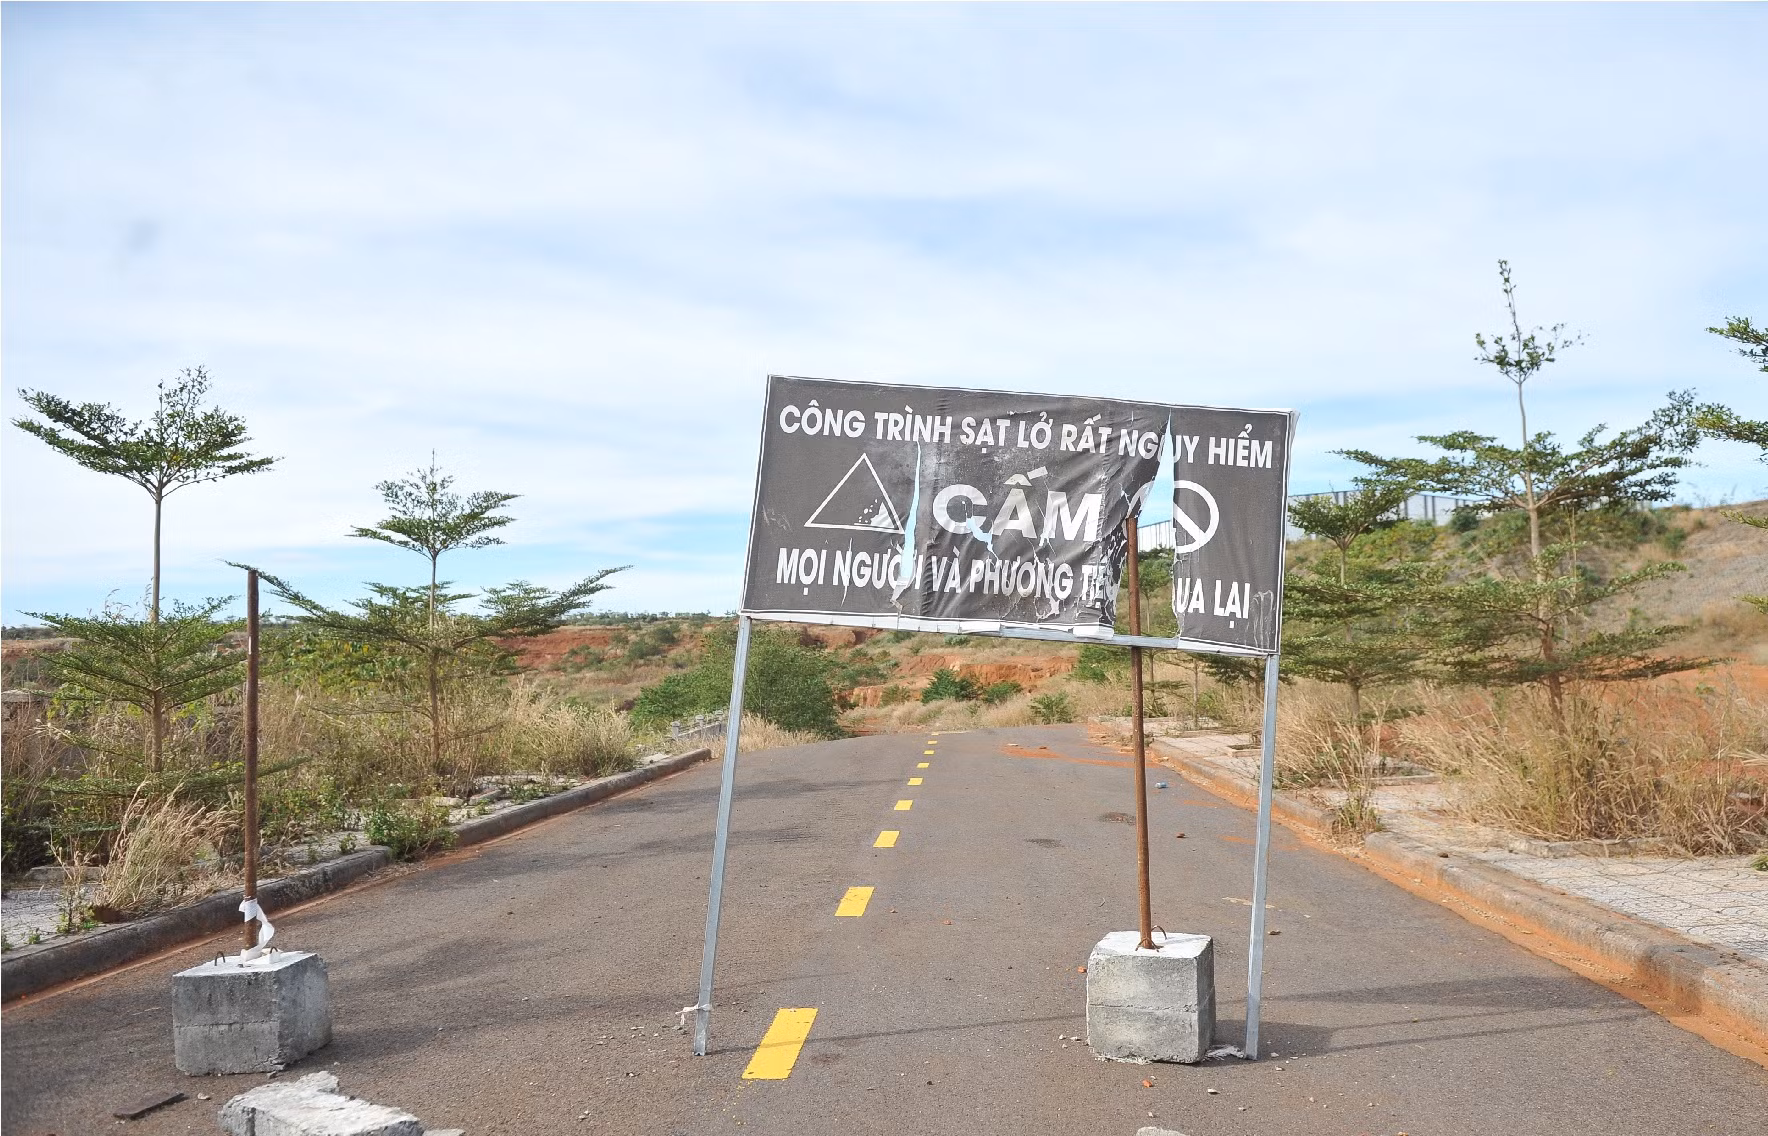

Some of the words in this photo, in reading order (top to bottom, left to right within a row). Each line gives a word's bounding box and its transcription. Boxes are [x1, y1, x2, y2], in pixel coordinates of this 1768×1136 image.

[779, 399, 866, 438] CÔNG
[874, 405, 953, 443] TRÌNH
[959, 416, 1011, 454] SẠT
[1017, 411, 1054, 450] LỞ
[1060, 413, 1113, 454] RẤT
[1118, 428, 1200, 464] NGUY
[1208, 423, 1273, 469] HIỂM
[932, 465, 1101, 542] CẤM
[776, 547, 828, 596] MỌI
[832, 543, 924, 590] NGƯỜI
[931, 546, 962, 593] VÀ
[969, 556, 1074, 601] PHƯƠNG
[1176, 577, 1205, 614] UA
[1213, 579, 1251, 629] LẠI
